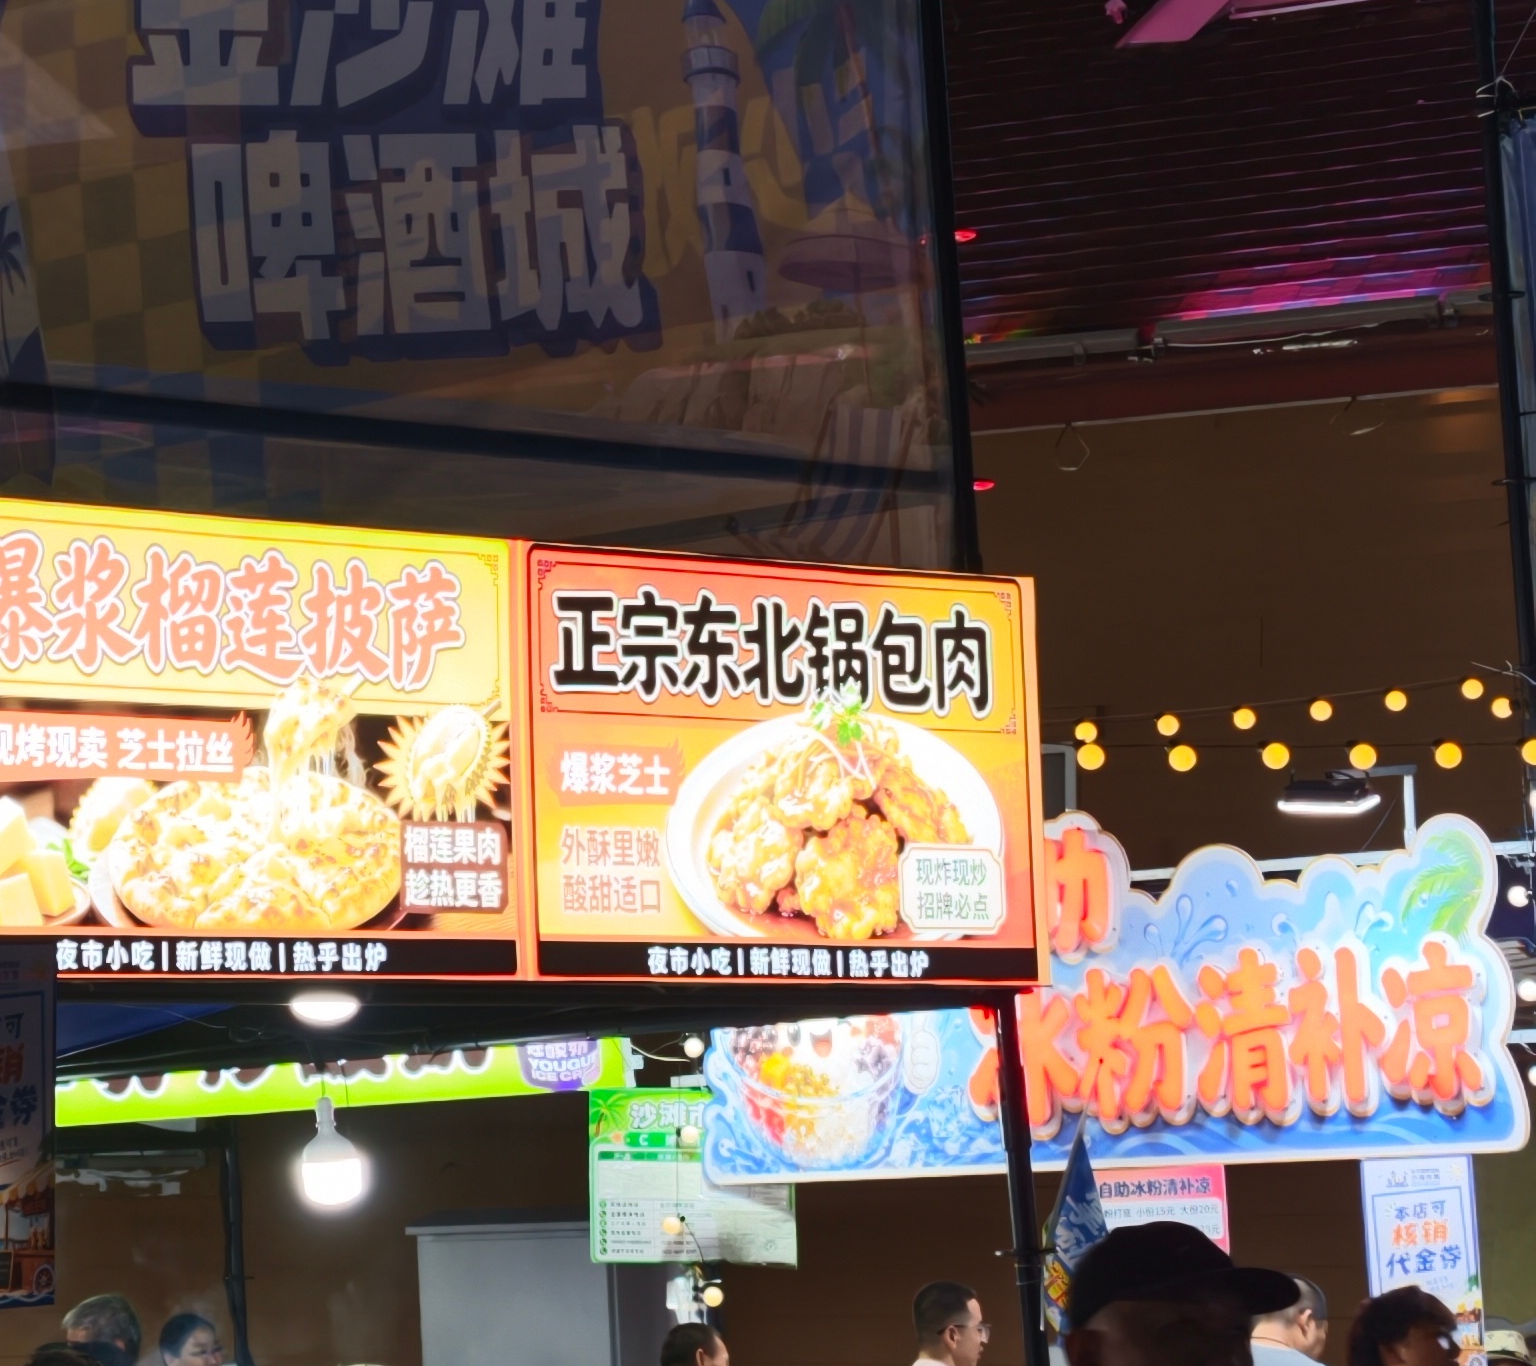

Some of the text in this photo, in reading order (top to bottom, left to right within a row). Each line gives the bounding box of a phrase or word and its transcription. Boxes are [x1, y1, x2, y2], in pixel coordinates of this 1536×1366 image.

[189, 123, 646, 347] 啤酒城
[554, 588, 992, 715] 正宗东北锅包肉
[117, 726, 234, 774] 芝士拉丝
[560, 751, 670, 795] 爆浆芝士
[404, 826, 501, 866] 榴莲果肉
[562, 827, 660, 866] 外酥里嫩
[404, 871, 502, 908] 趁热更香
[916, 857, 986, 887] 现炸现炒
[562, 874, 661, 914] 酸甜适口
[917, 891, 990, 921] 招牌必点
[56, 939, 387, 974] 夜市小吃 新鲜现做 热乎出炉
[648, 947, 929, 978] 夜市小吃 新鲜现做 热乎出炉
[1100, 1177, 1211, 1199] 自助冰粉清补凉
